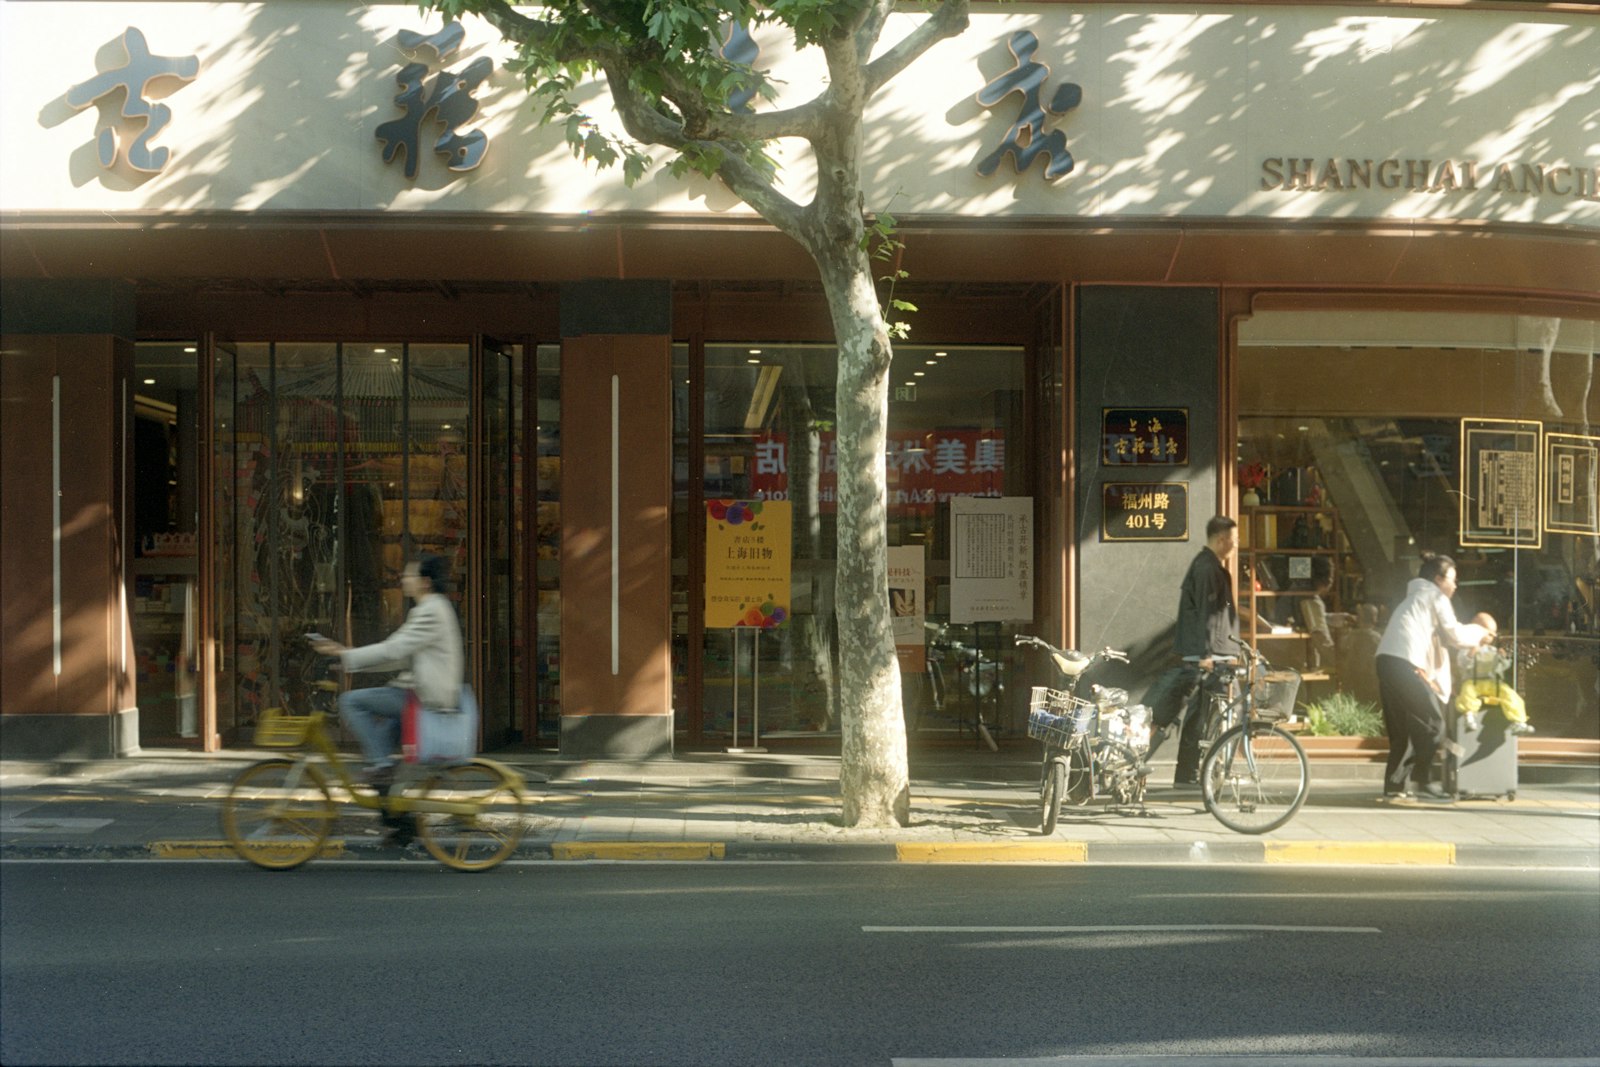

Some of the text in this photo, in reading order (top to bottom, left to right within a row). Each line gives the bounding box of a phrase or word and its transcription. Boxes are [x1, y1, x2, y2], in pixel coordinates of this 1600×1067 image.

[1261, 157, 1479, 194] SHANGHAI
[1122, 493, 1170, 509] 福州路
[1125, 513, 1167, 530] 401号
[727, 546, 773, 560] 上海旧物
